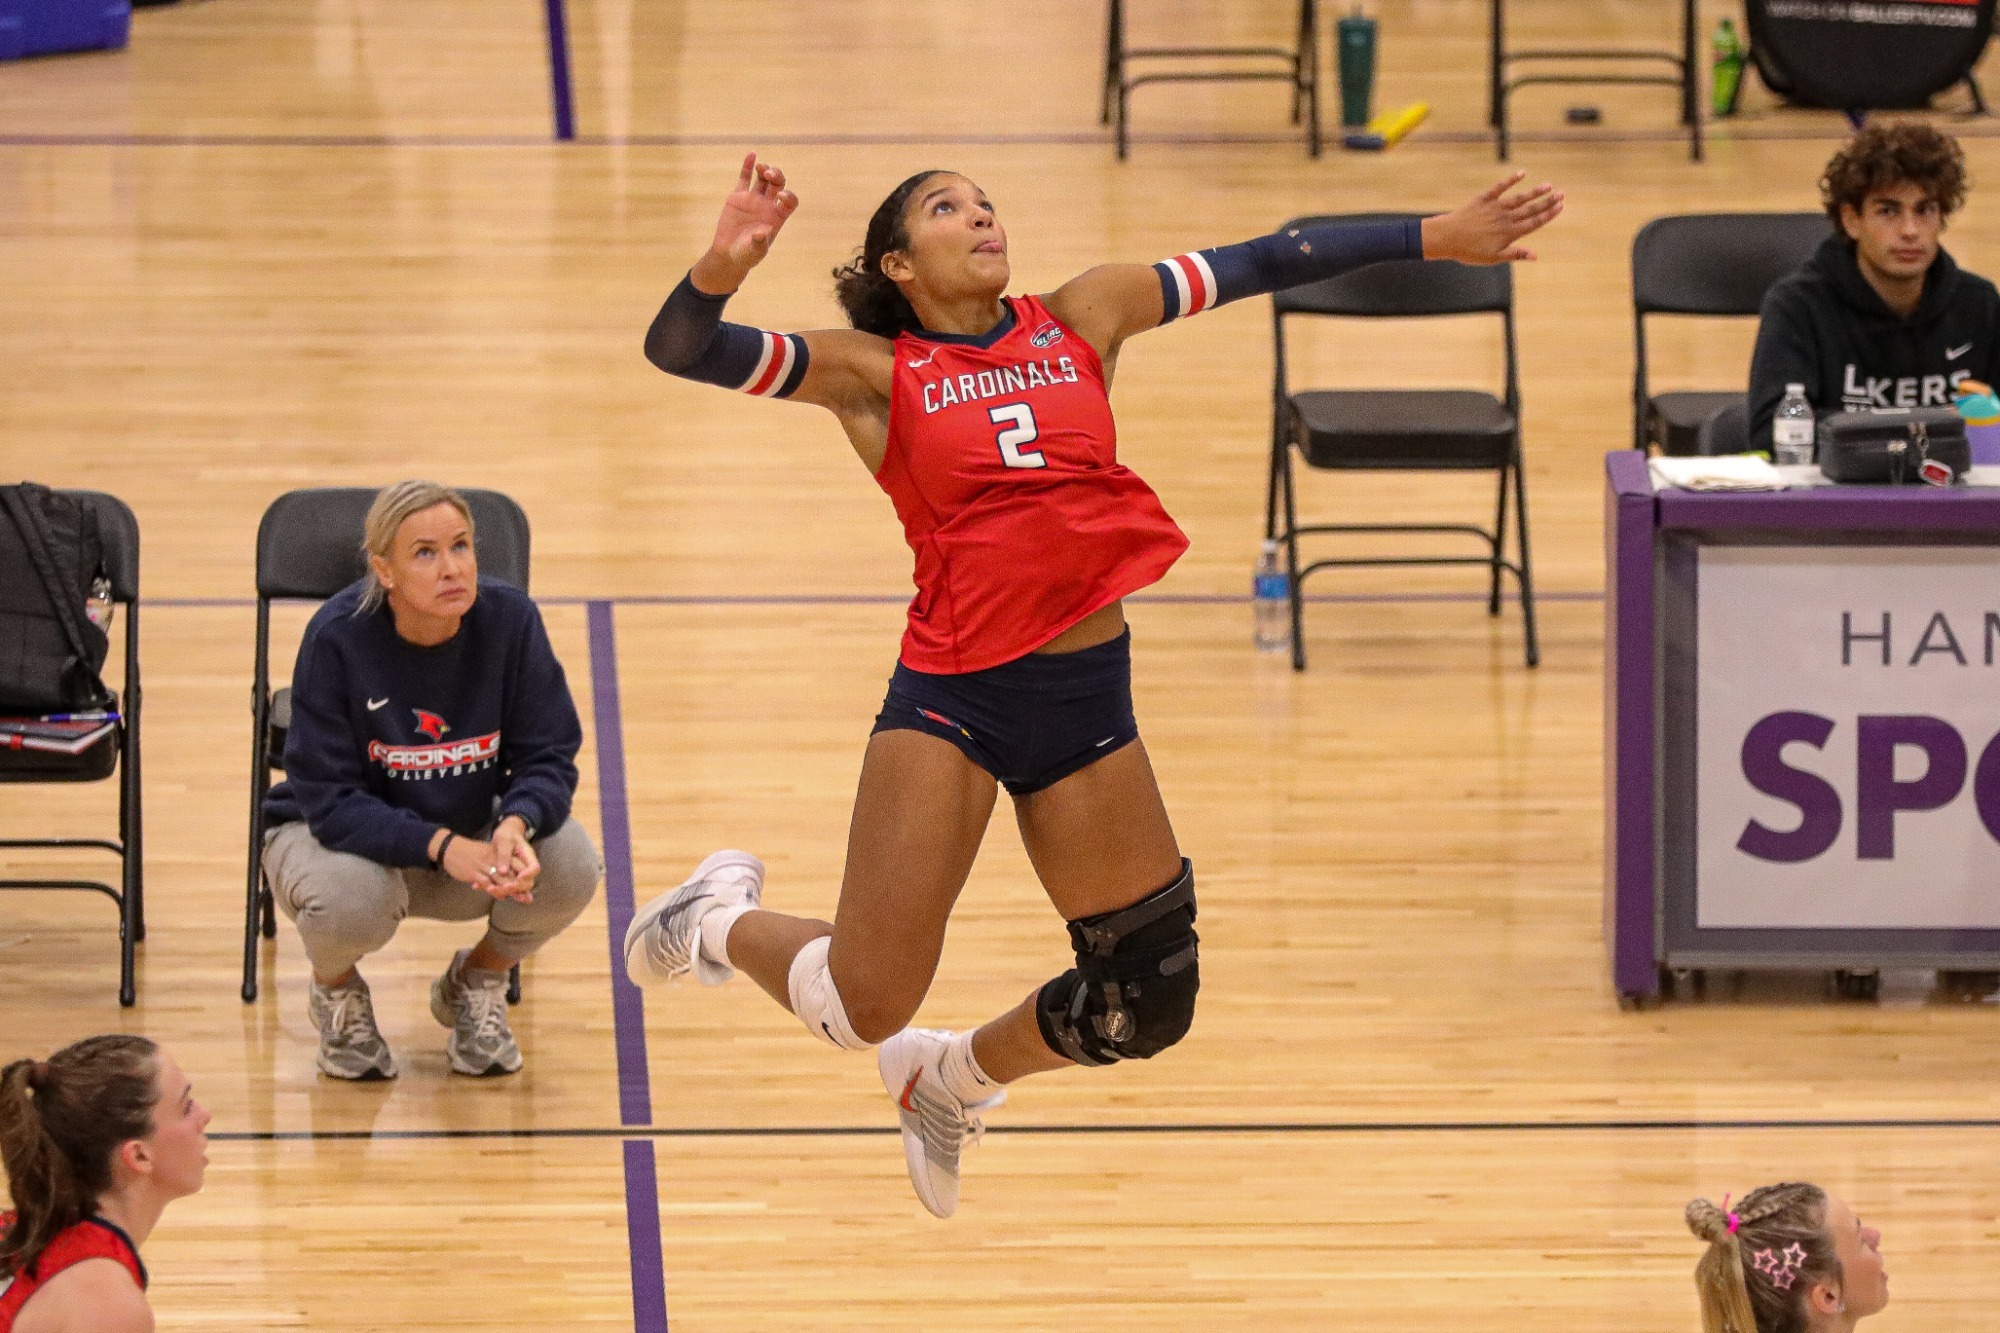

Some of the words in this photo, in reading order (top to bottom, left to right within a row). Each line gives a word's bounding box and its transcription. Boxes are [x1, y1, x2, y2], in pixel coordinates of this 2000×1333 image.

[924, 356, 1079, 414] CARDINALS
[987, 401, 1047, 469] 2
[1736, 711, 2000, 864] SP
